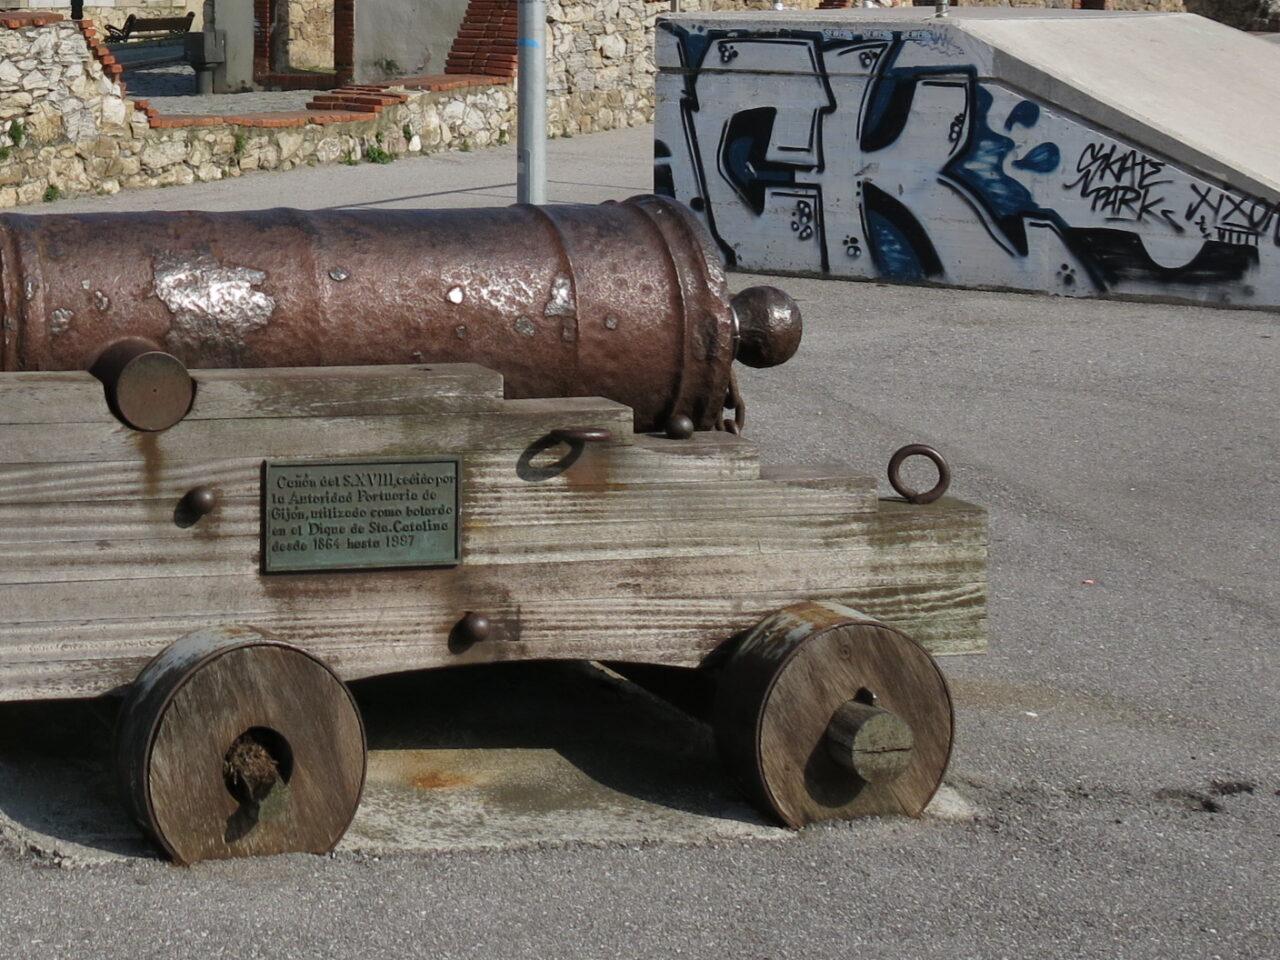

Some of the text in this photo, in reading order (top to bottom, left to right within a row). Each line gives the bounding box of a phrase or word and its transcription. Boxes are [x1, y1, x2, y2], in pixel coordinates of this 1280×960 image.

[1077, 143, 1173, 189] SKATE
[1081, 184, 1171, 224] PARK
[320, 475, 340, 487] del
[436, 474, 456, 487] por
[272, 488, 437, 505] la Autoridad Portuaria de
[310, 506, 367, 519] utilizado
[370, 508, 402, 518] como
[406, 504, 454, 517] bolardo
[272, 527, 286, 536] en
[291, 525, 302, 536] el
[308, 522, 346, 537] Dique
[350, 523, 365, 534] de
[272, 540, 308, 552] desde
[313, 537, 341, 550] 1864
[347, 537, 380, 549] hasta
